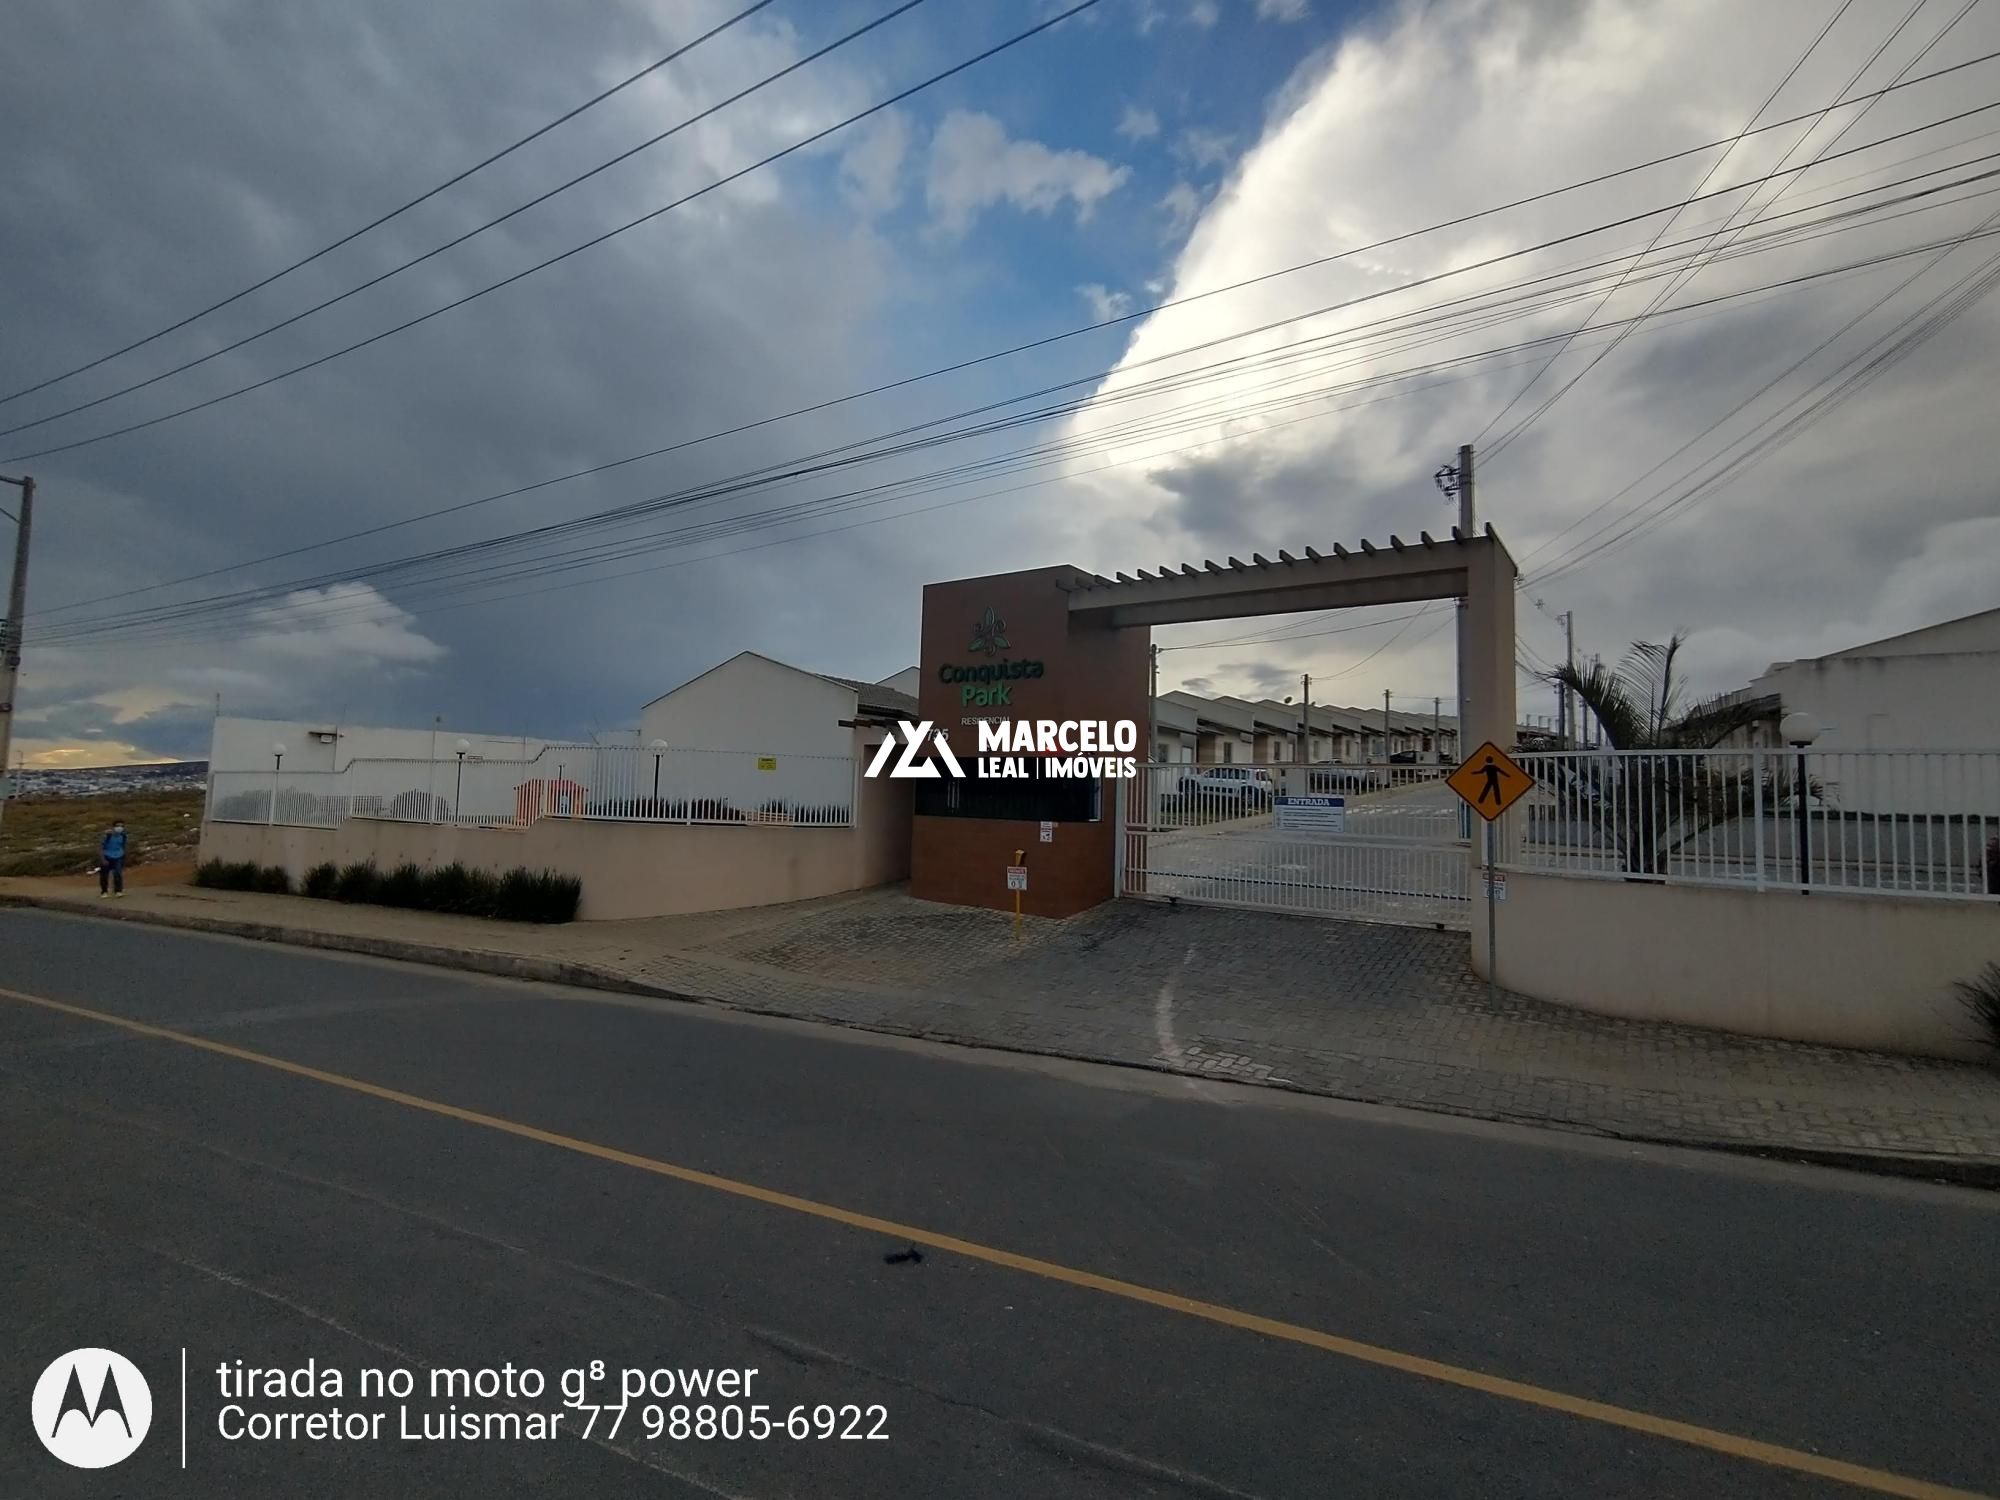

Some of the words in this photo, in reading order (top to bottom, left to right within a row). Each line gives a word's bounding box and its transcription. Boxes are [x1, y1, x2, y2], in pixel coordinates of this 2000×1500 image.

[939, 659, 1044, 685] Conquista
[961, 682, 1012, 707] Park
[1287, 798, 1330, 806] ENTRADA
